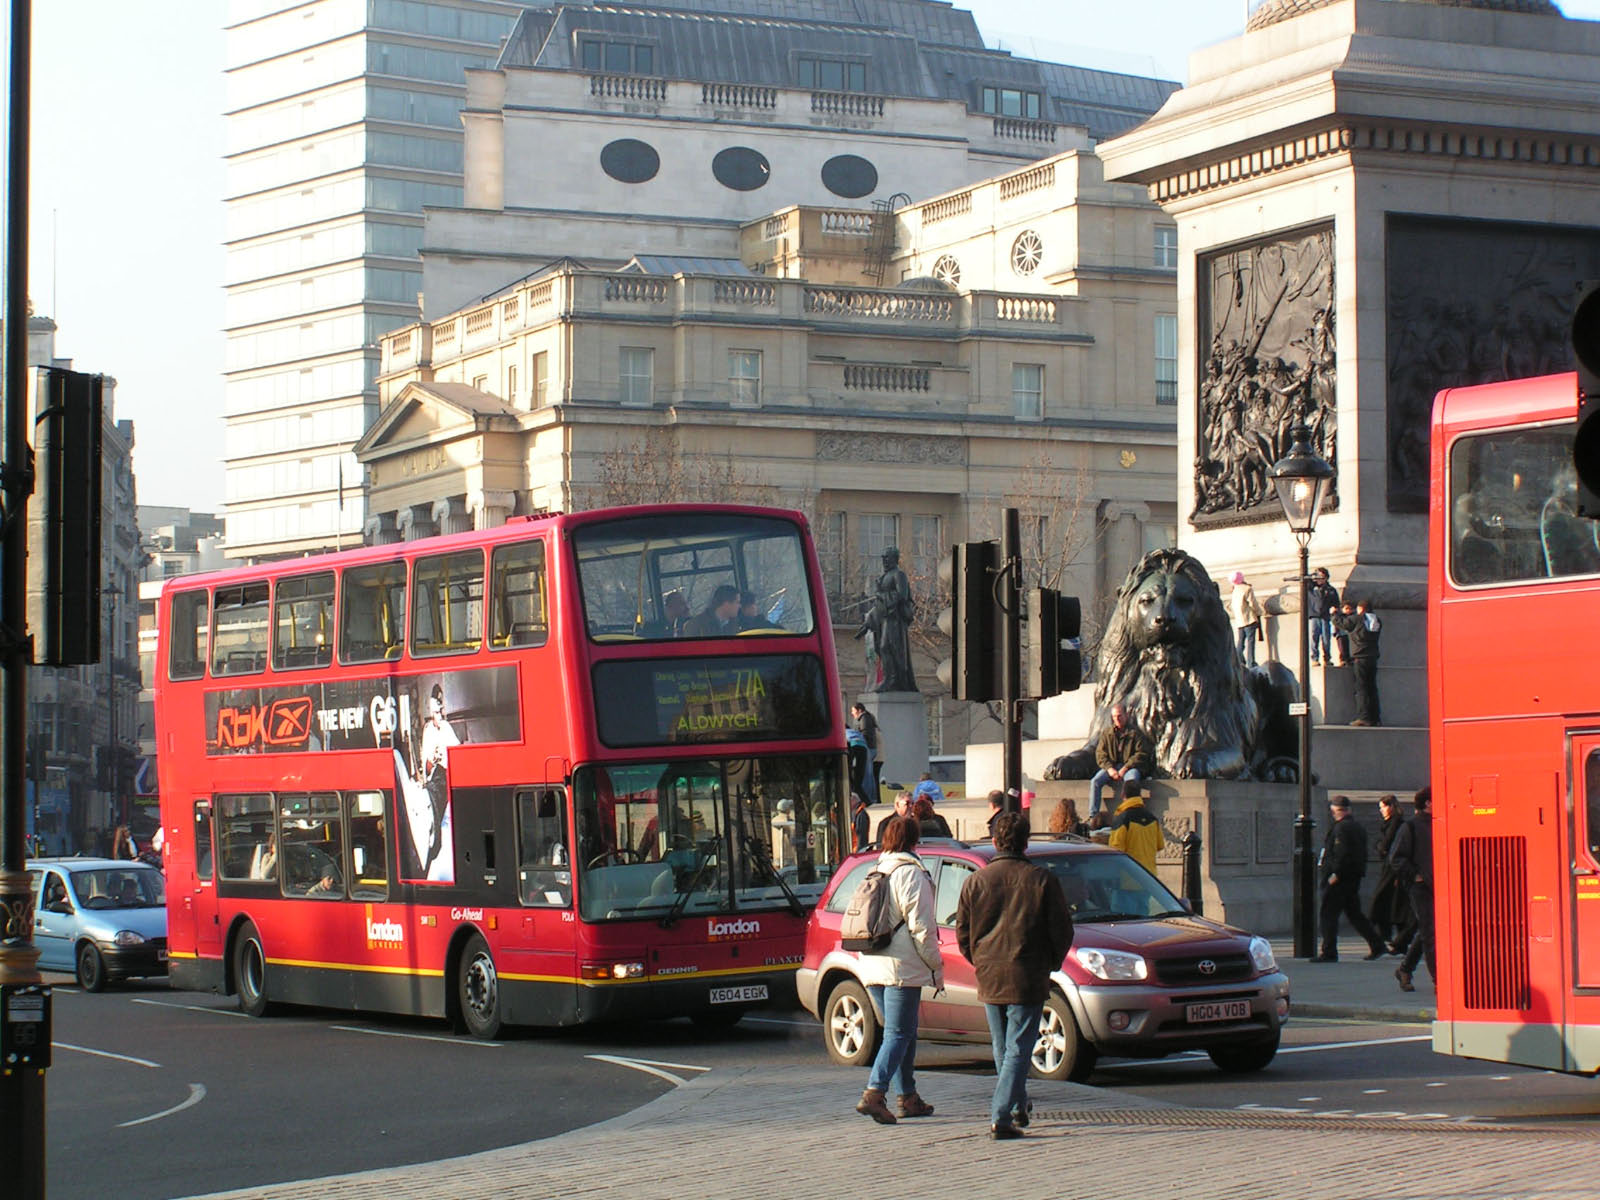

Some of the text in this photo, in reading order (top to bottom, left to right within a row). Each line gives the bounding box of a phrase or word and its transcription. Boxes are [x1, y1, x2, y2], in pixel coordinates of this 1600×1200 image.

[732, 670, 766, 697] 77A
[317, 709, 338, 732] THE
[339, 706, 364, 732] NEW
[678, 712, 758, 729] ALDWYCH
[451, 907, 483, 921] Go-Ahead
[367, 917, 403, 942] London
[708, 919, 760, 936] London
[658, 966, 698, 974] DENNIS
[711, 986, 766, 1002] X604 EGK
[1191, 1003, 1246, 1019] HG04 VOB
